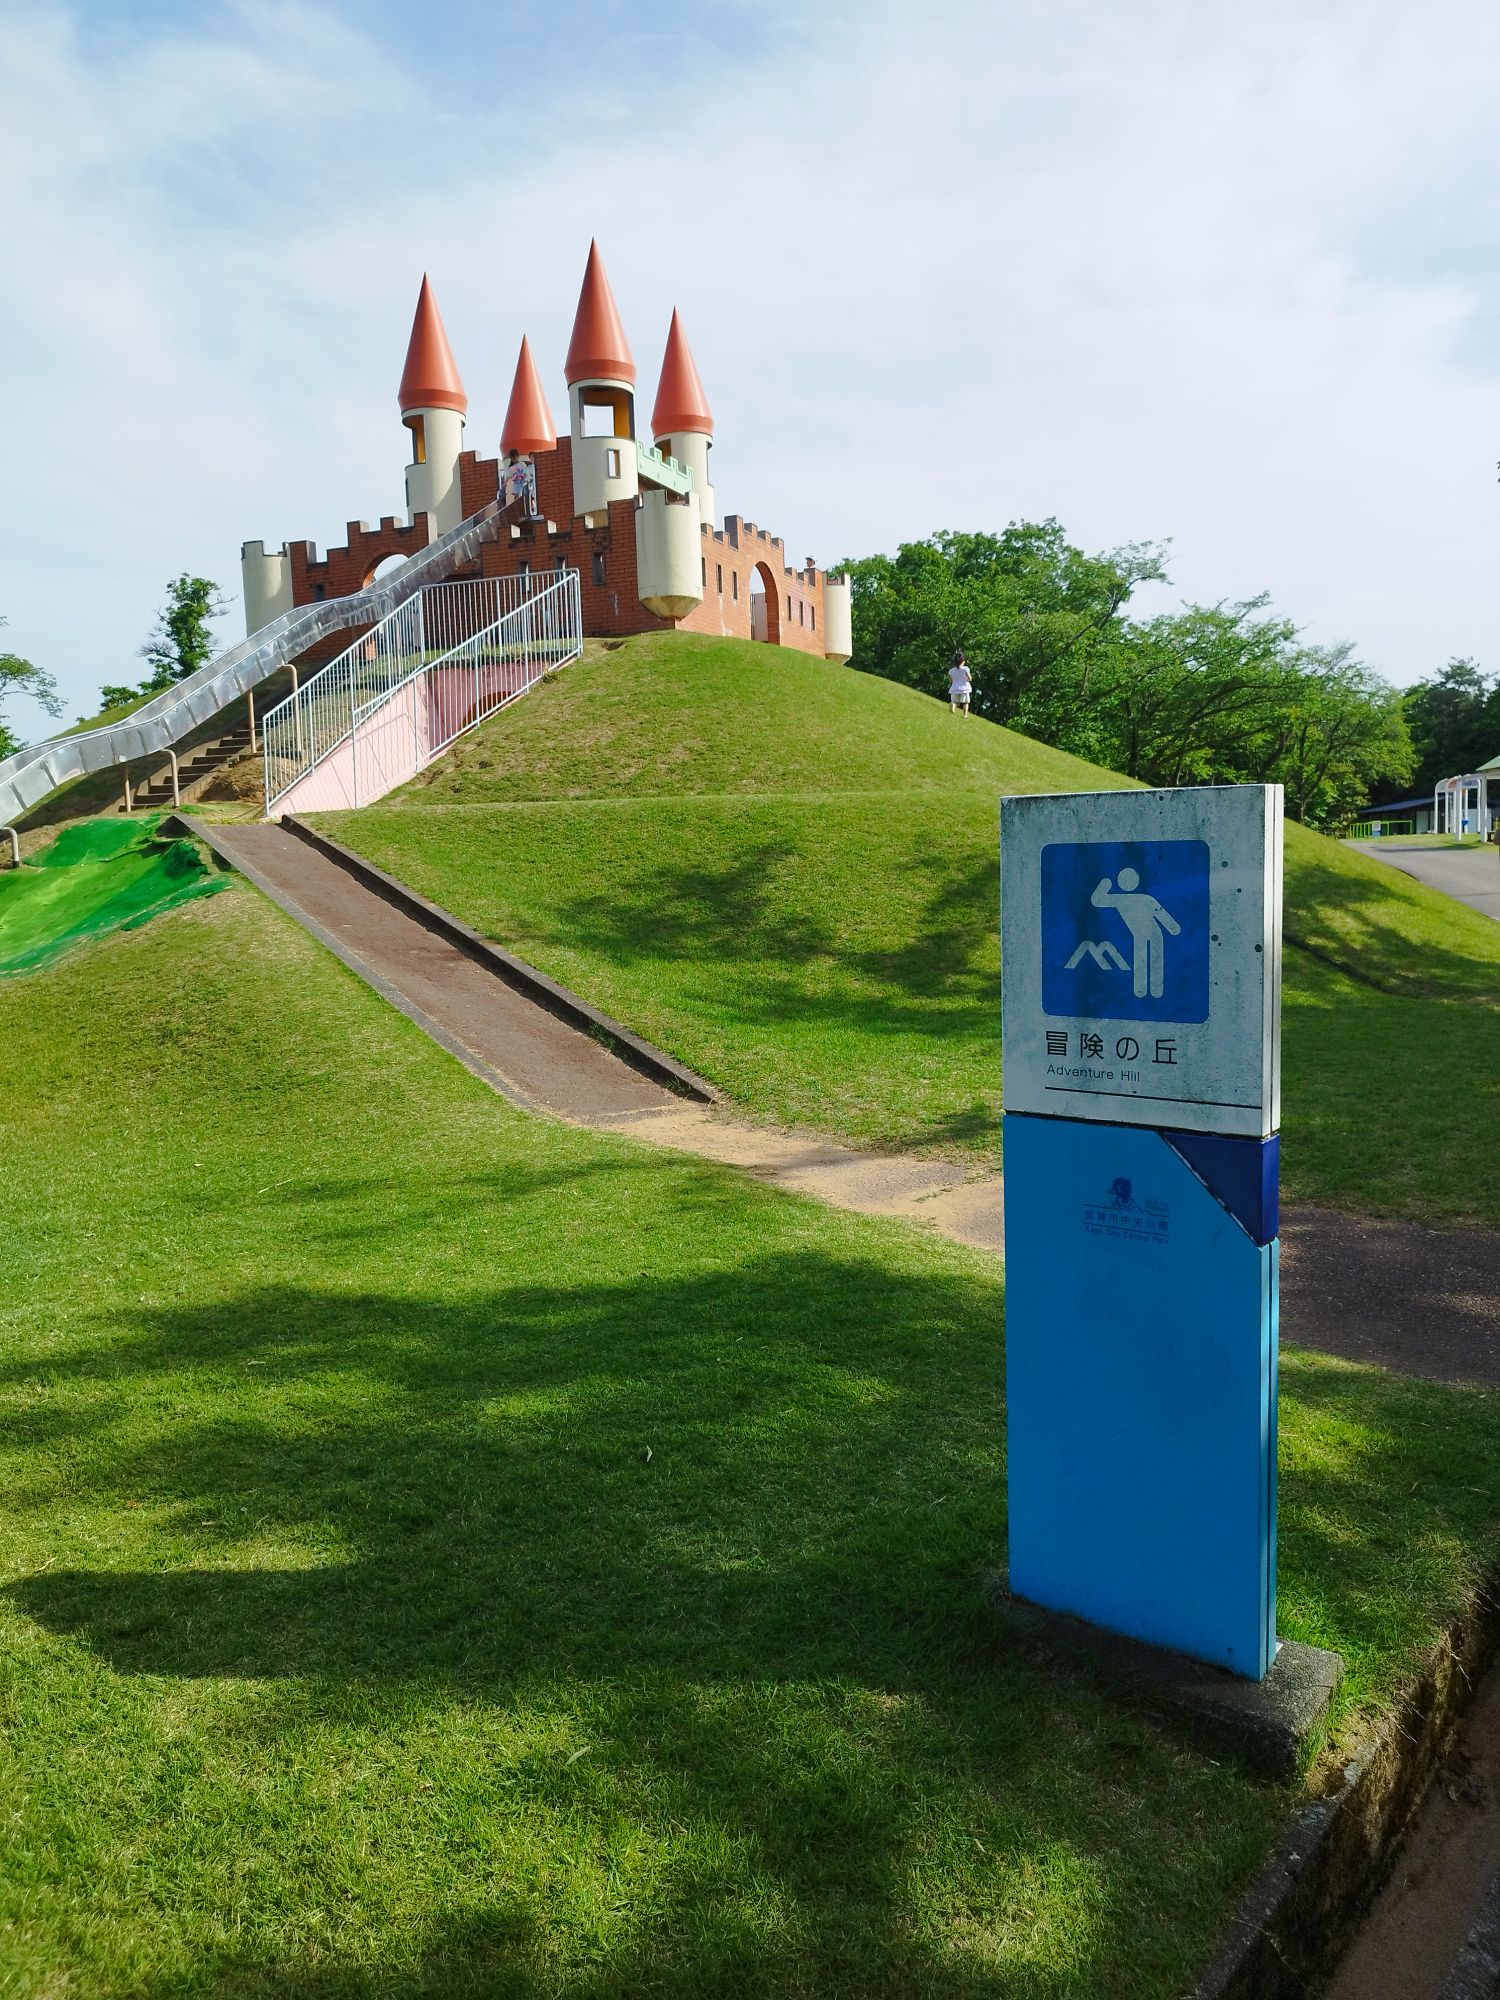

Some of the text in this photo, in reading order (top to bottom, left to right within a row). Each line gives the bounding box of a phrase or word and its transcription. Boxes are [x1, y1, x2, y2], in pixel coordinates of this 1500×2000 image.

[1045, 1030, 1178, 1065] 冒険の丘
[1046, 1064, 1140, 1082] Adventure Hill
